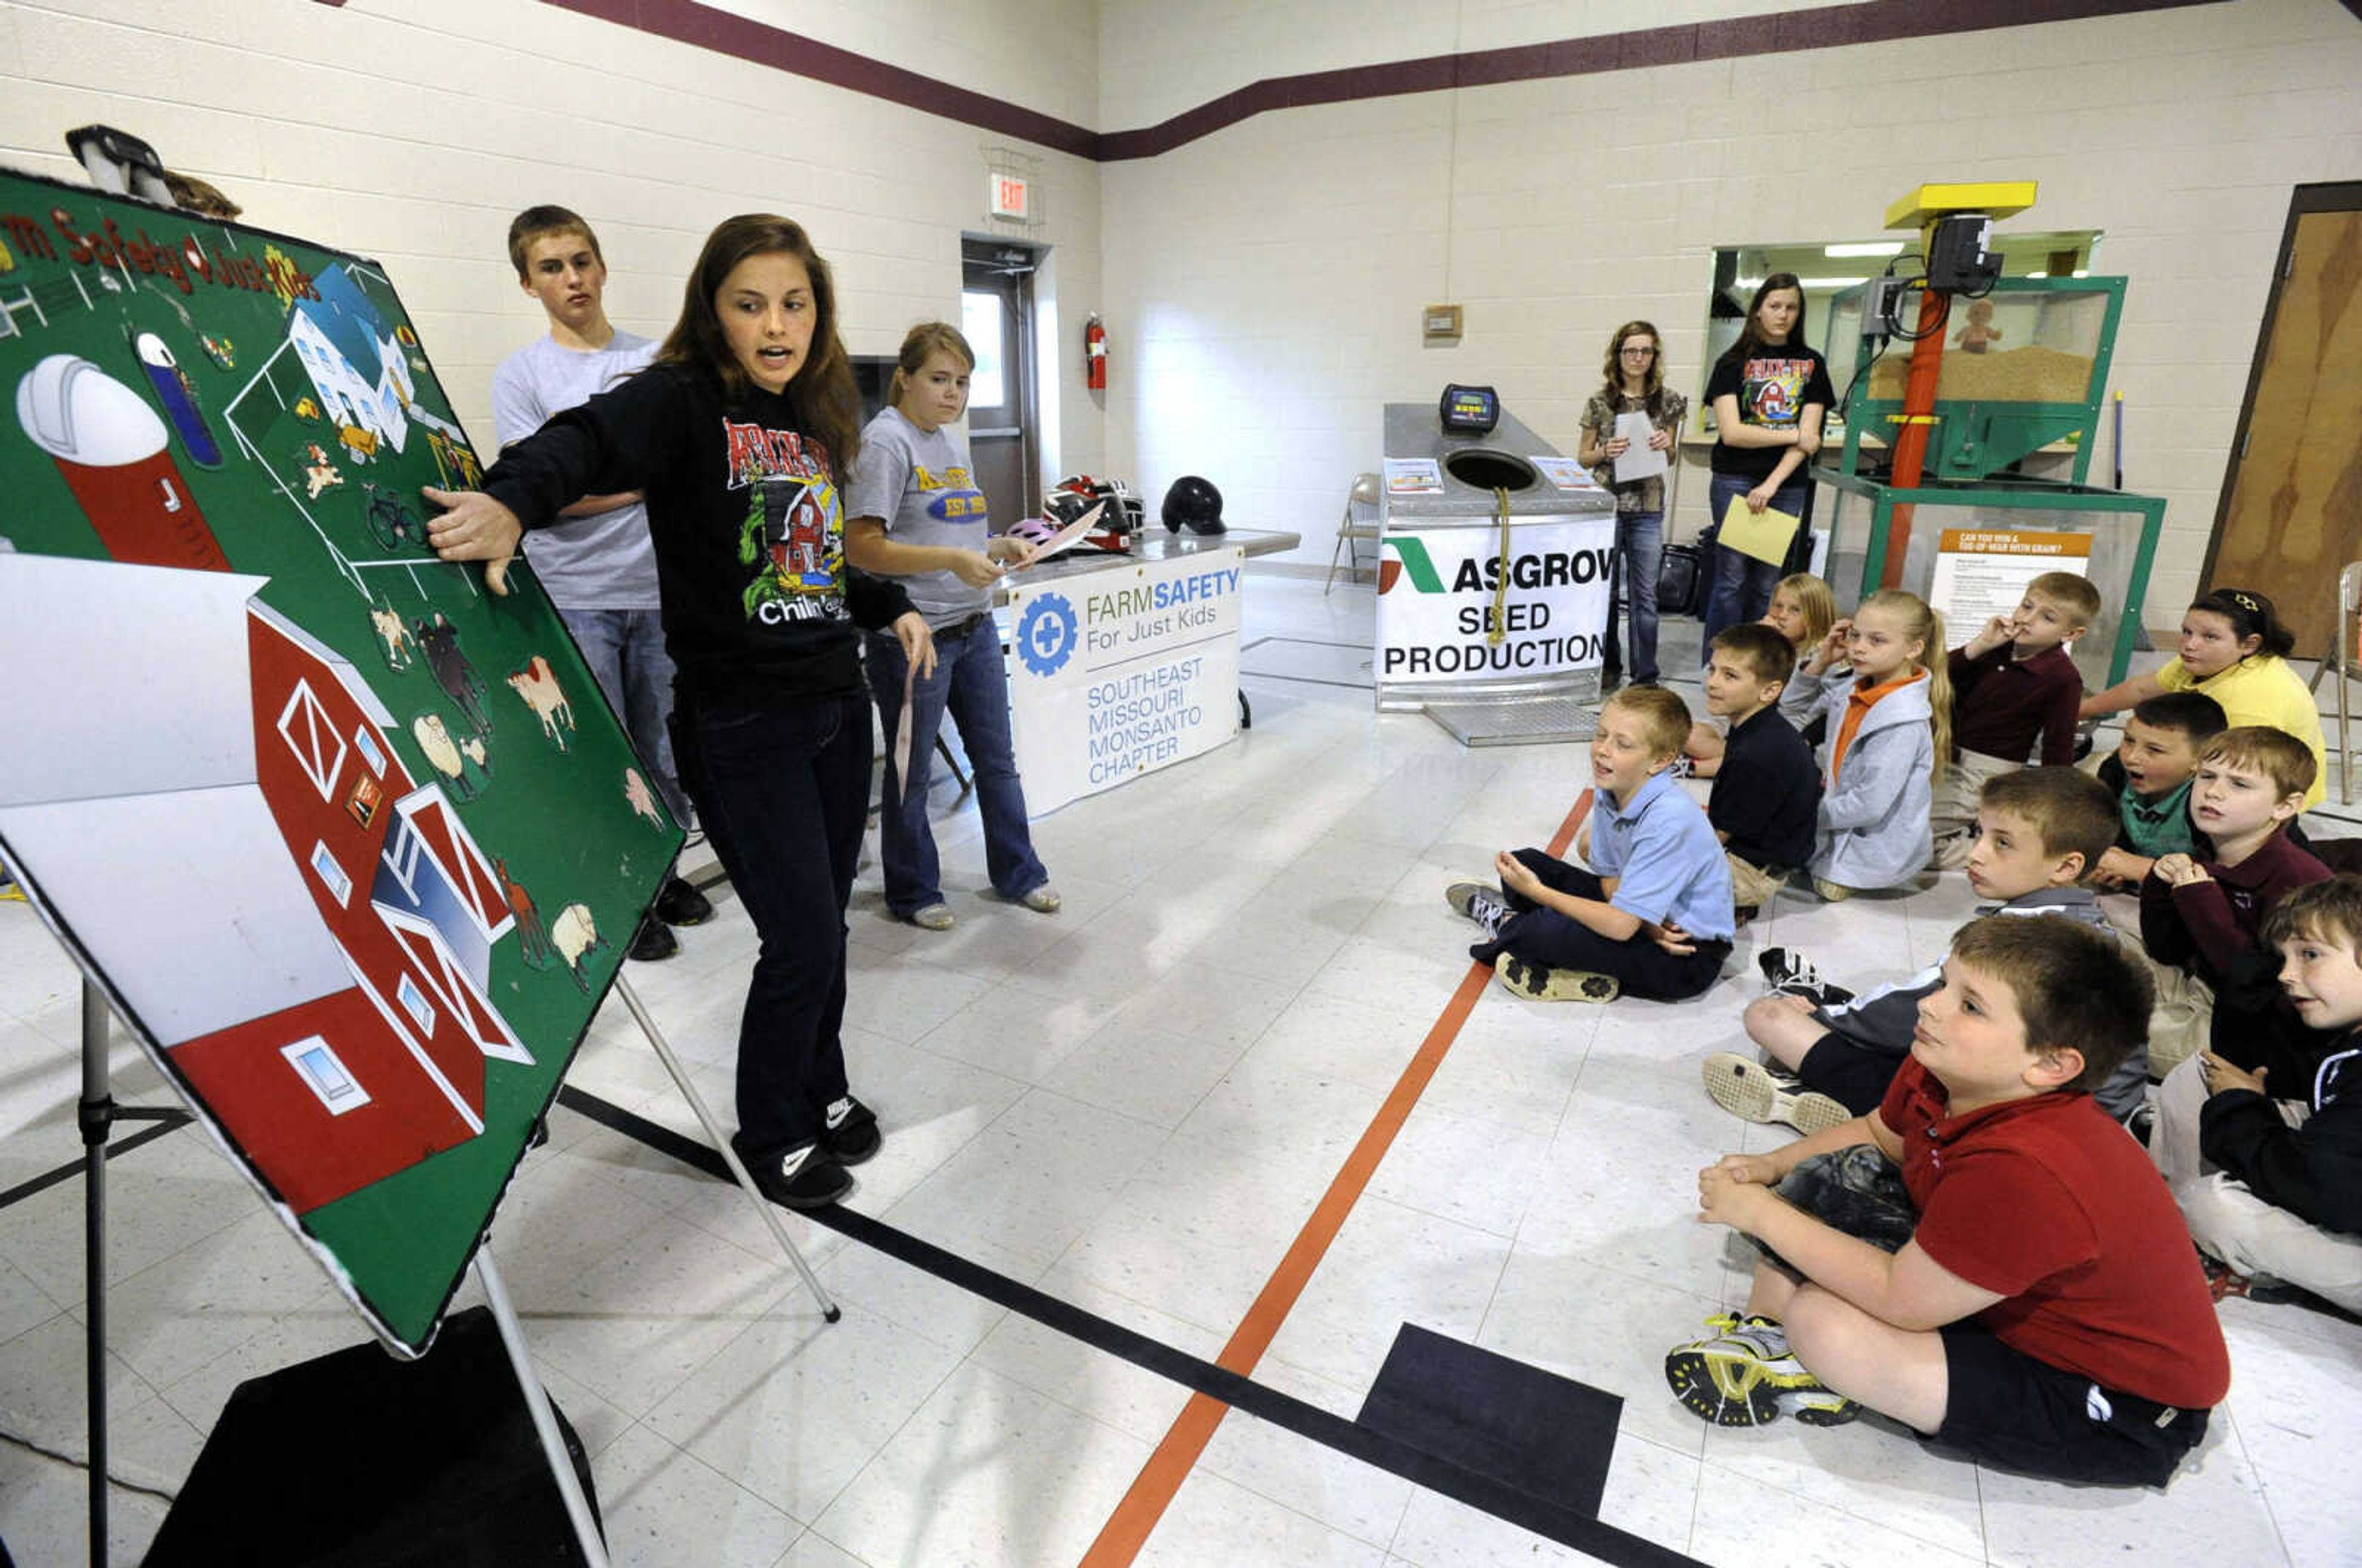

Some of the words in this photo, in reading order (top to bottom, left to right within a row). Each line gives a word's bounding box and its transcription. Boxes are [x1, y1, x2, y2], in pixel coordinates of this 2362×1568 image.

[1001, 180, 1024, 211] EXIT
[1087, 567, 1240, 625] FARMSAFETY
[1458, 602, 1550, 635] SEED
[1088, 630, 1120, 651] For
[1128, 618, 1171, 642] Just
[1179, 606, 1216, 629] Kids
[1384, 632, 1607, 674] PRODUCTION
[1088, 657, 1203, 709] SOUTHEAST
[1089, 686, 1184, 734] MISSOURI
[1089, 706, 1202, 762] MONSANTO
[1089, 736, 1179, 784] CHAPTER
